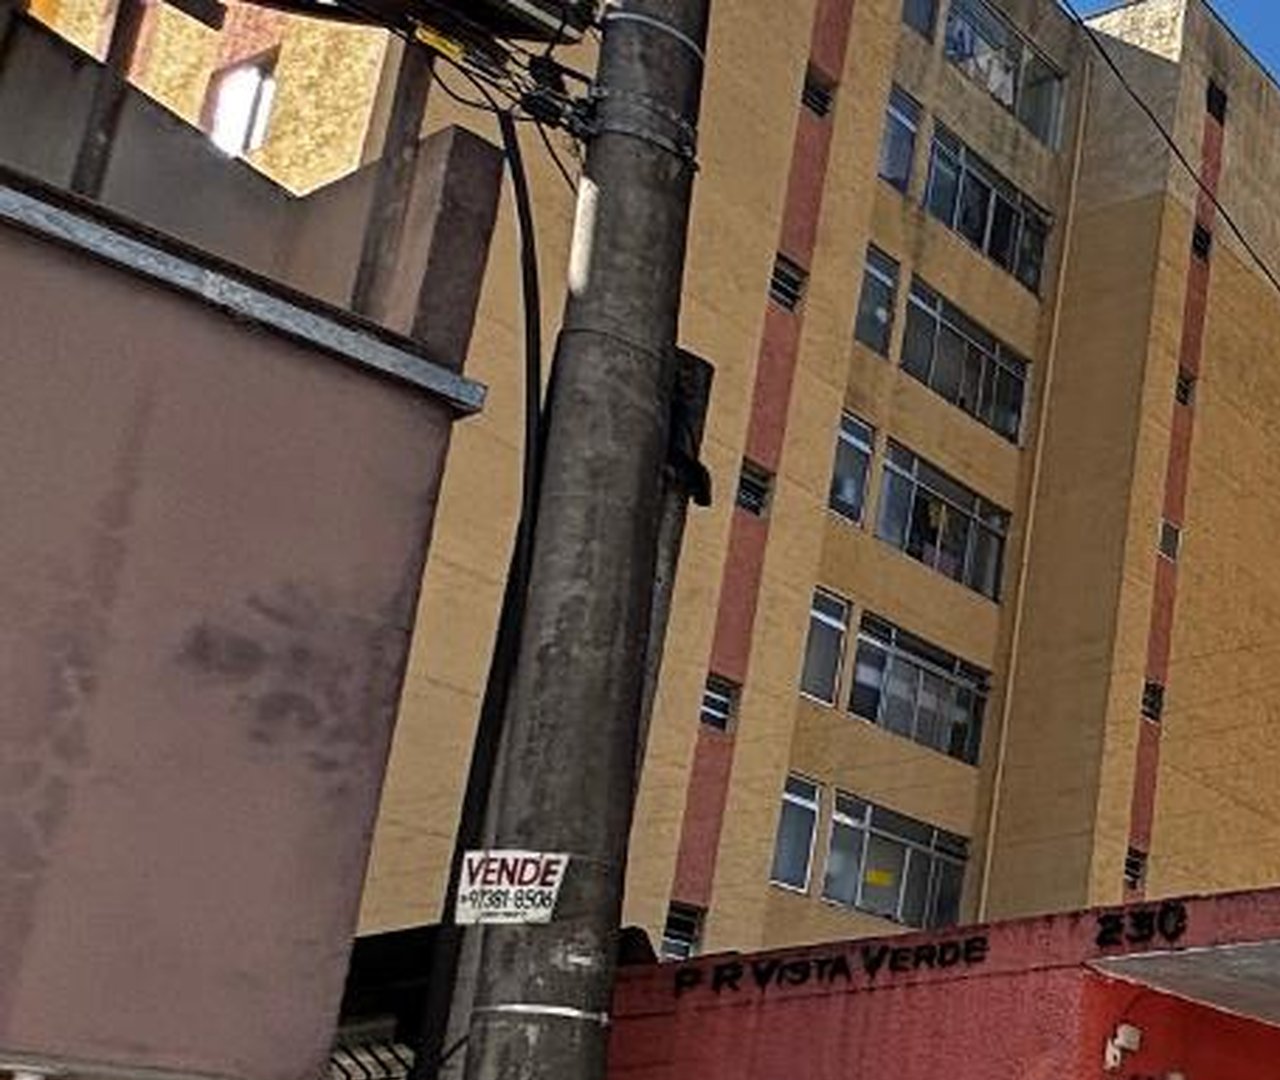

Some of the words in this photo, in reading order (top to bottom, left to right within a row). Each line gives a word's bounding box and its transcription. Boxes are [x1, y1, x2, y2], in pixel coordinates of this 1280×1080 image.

[466, 857, 562, 887] VENDE
[752, 954, 852, 996] VISTA
[861, 935, 990, 986] VERDE
